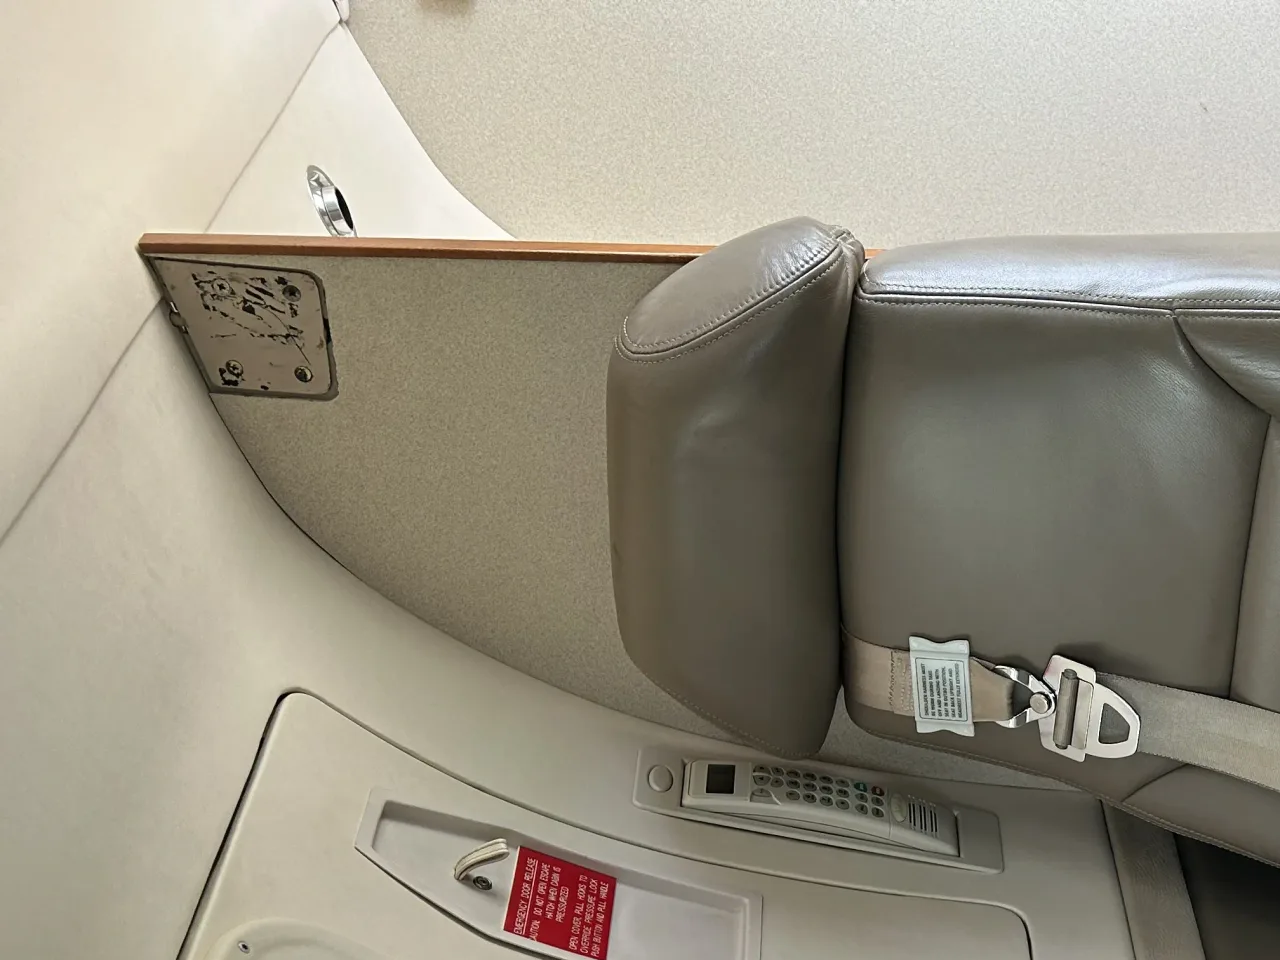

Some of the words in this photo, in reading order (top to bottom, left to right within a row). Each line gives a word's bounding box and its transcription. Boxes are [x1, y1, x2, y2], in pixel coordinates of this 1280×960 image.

[524, 857, 536, 880] RELEASE
[540, 863, 550, 881] ESCAPE
[550, 872, 560, 886] CABIN
[579, 874, 588, 882] TO
[521, 883, 530, 899] DOOR
[538, 881, 547, 894] OPEN
[548, 888, 558, 901] WHEN
[577, 884, 587, 900] HOOKS
[600, 881, 609, 898] HANDLE
[536, 896, 544, 907] NOT
[556, 886, 569, 922] PRESSURIZED
[575, 902, 584, 915] PULL
[585, 895, 595, 923] PRESSURE
[598, 902, 606, 913] PULL
[514, 900, 527, 934] EMERGENCY
[533, 908, 543, 916] DO
[545, 902, 555, 919] HATCH
[596, 913, 604, 923] AND
[580, 926, 592, 954] OVERRIDE
[593, 924, 603, 943] BUTTON
[569, 936, 578, 950] OPEN
[591, 944, 599, 957] PUSH
